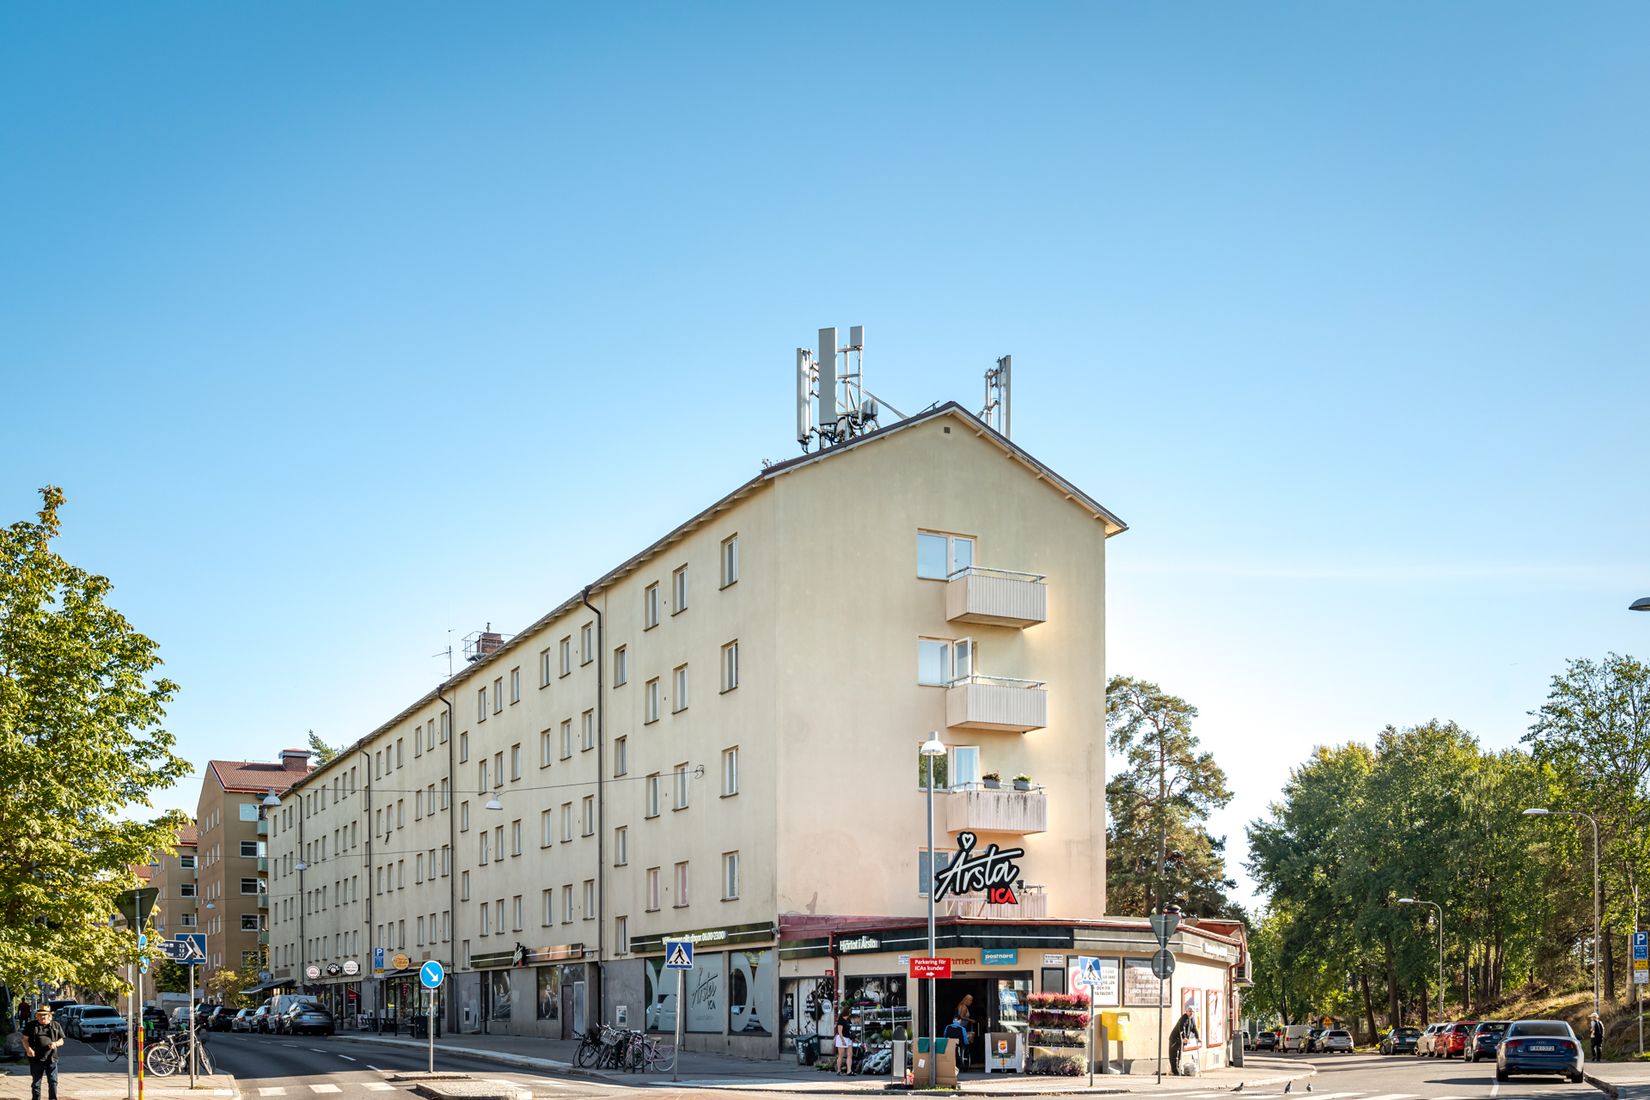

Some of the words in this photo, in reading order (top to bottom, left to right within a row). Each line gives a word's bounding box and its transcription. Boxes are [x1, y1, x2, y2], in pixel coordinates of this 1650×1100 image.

[935, 833, 1021, 900] Årsta
[990, 888, 1017, 904] ICA
[1636, 933, 1646, 945] P
[985, 953, 1014, 961] postnord
